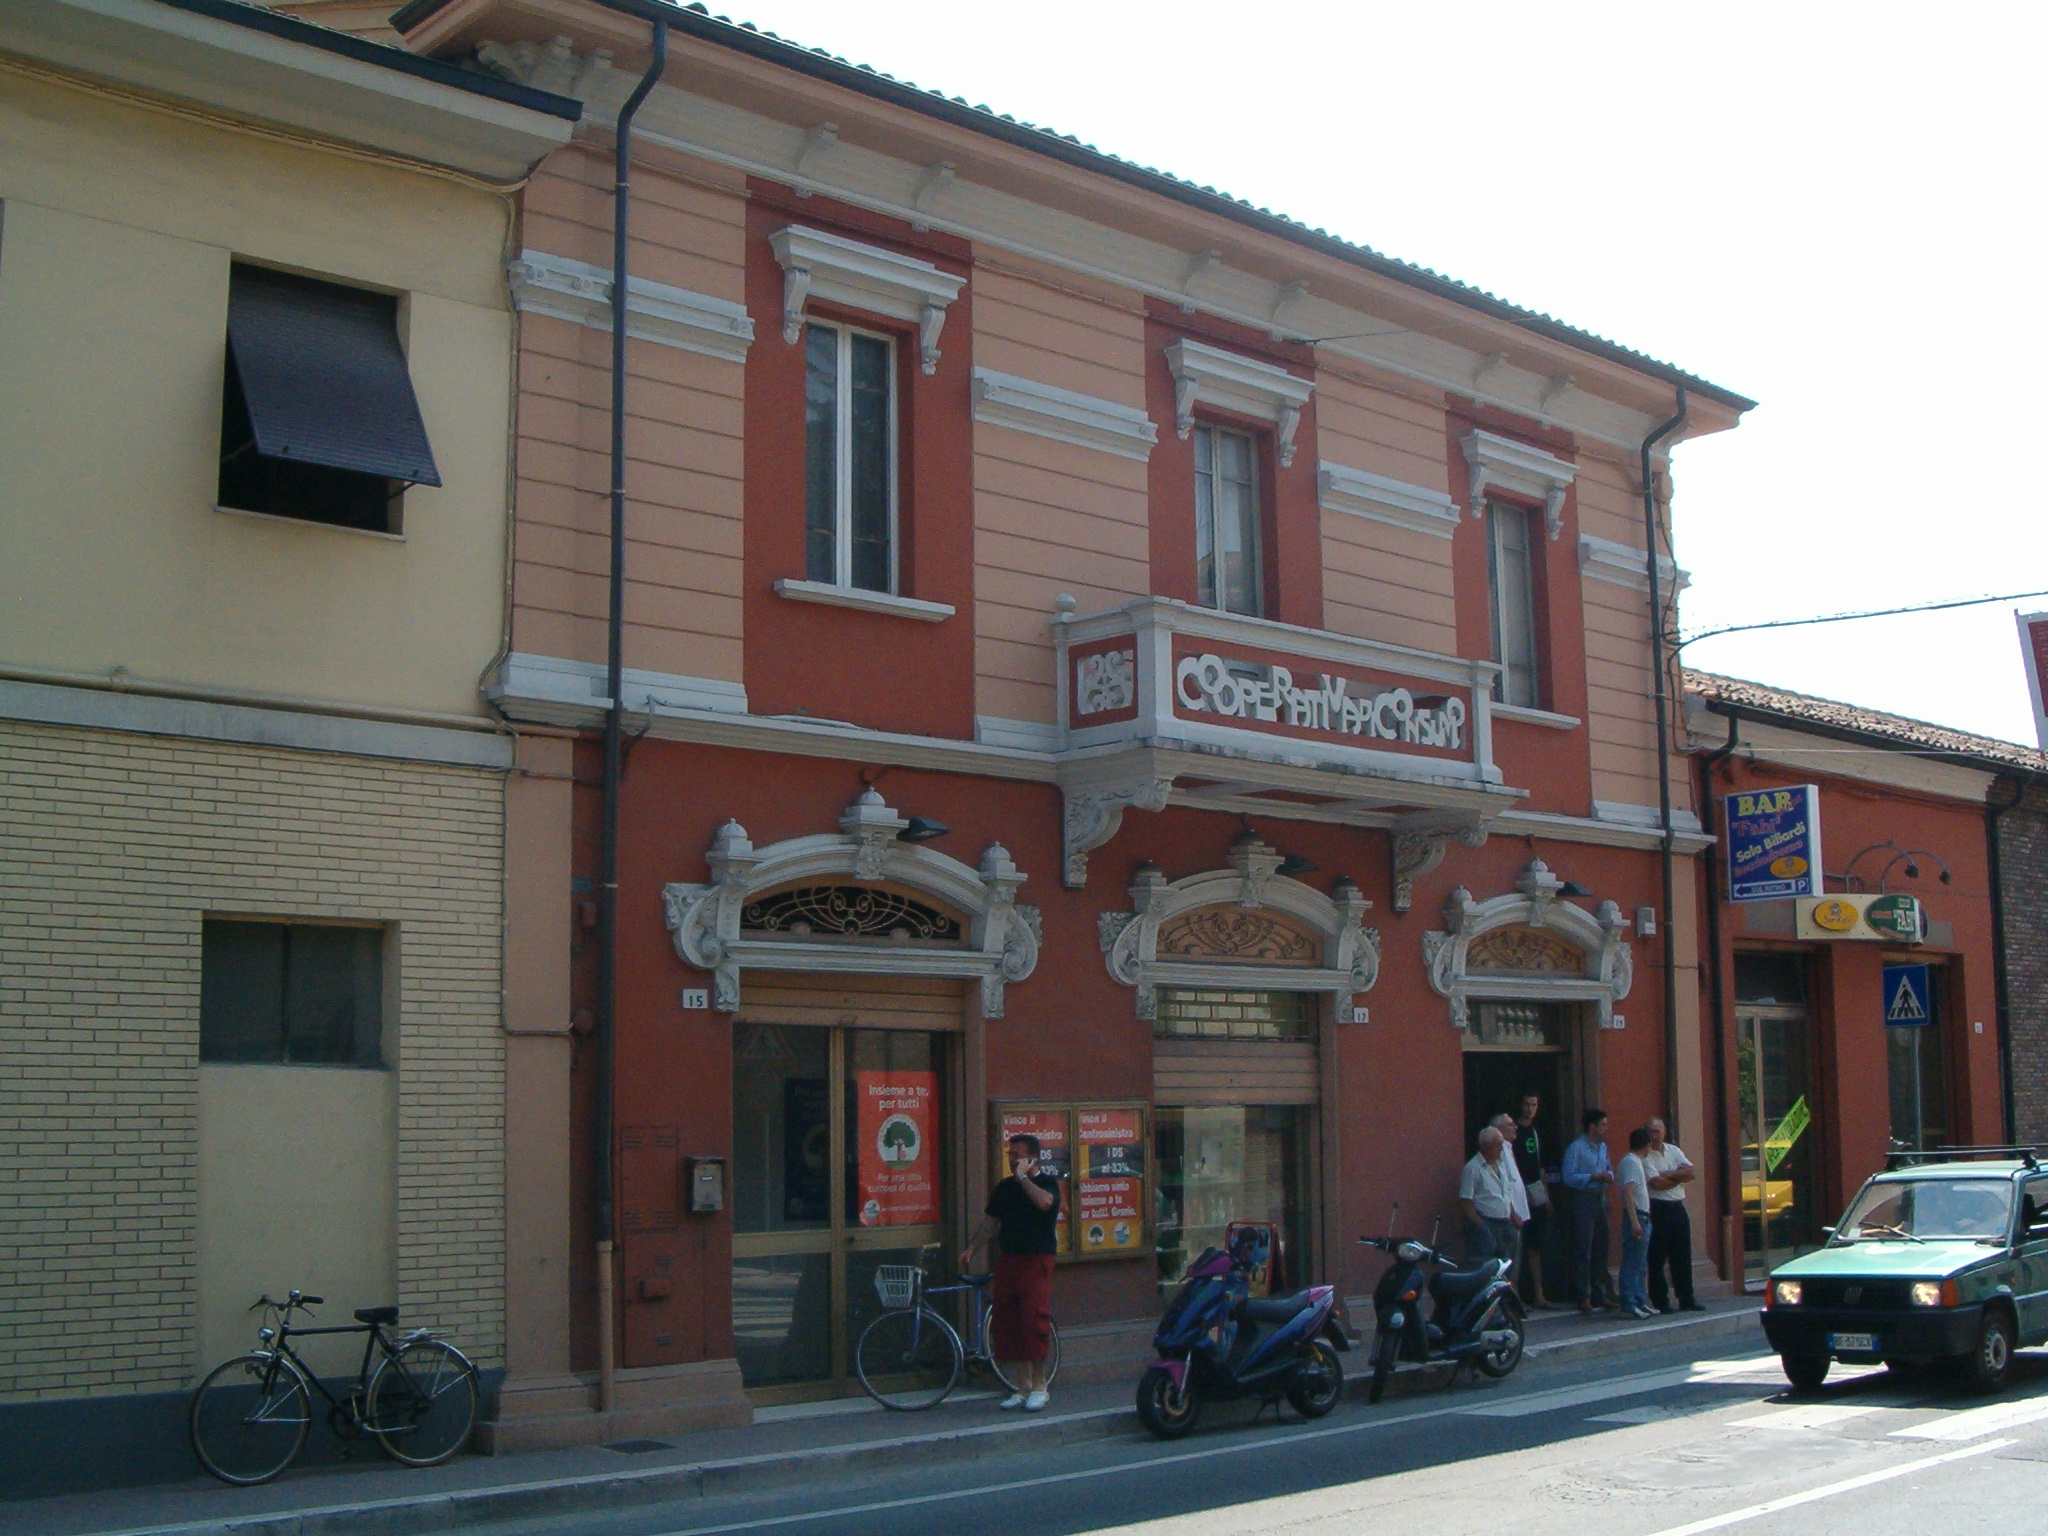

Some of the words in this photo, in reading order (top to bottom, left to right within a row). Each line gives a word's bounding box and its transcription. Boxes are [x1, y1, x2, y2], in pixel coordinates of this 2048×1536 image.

[1737, 792, 1793, 816] BAR
[1736, 844, 1762, 862] Sala
[1797, 880, 1806, 893] P
[688, 994, 704, 1008] 15
[869, 1085, 906, 1096] Insieme
[908, 1087, 914, 1096] a
[915, 1085, 928, 1098] te,
[879, 1099, 895, 1111] per
[897, 1096, 919, 1109] tutti
[1112, 1147, 1123, 1158] DS
